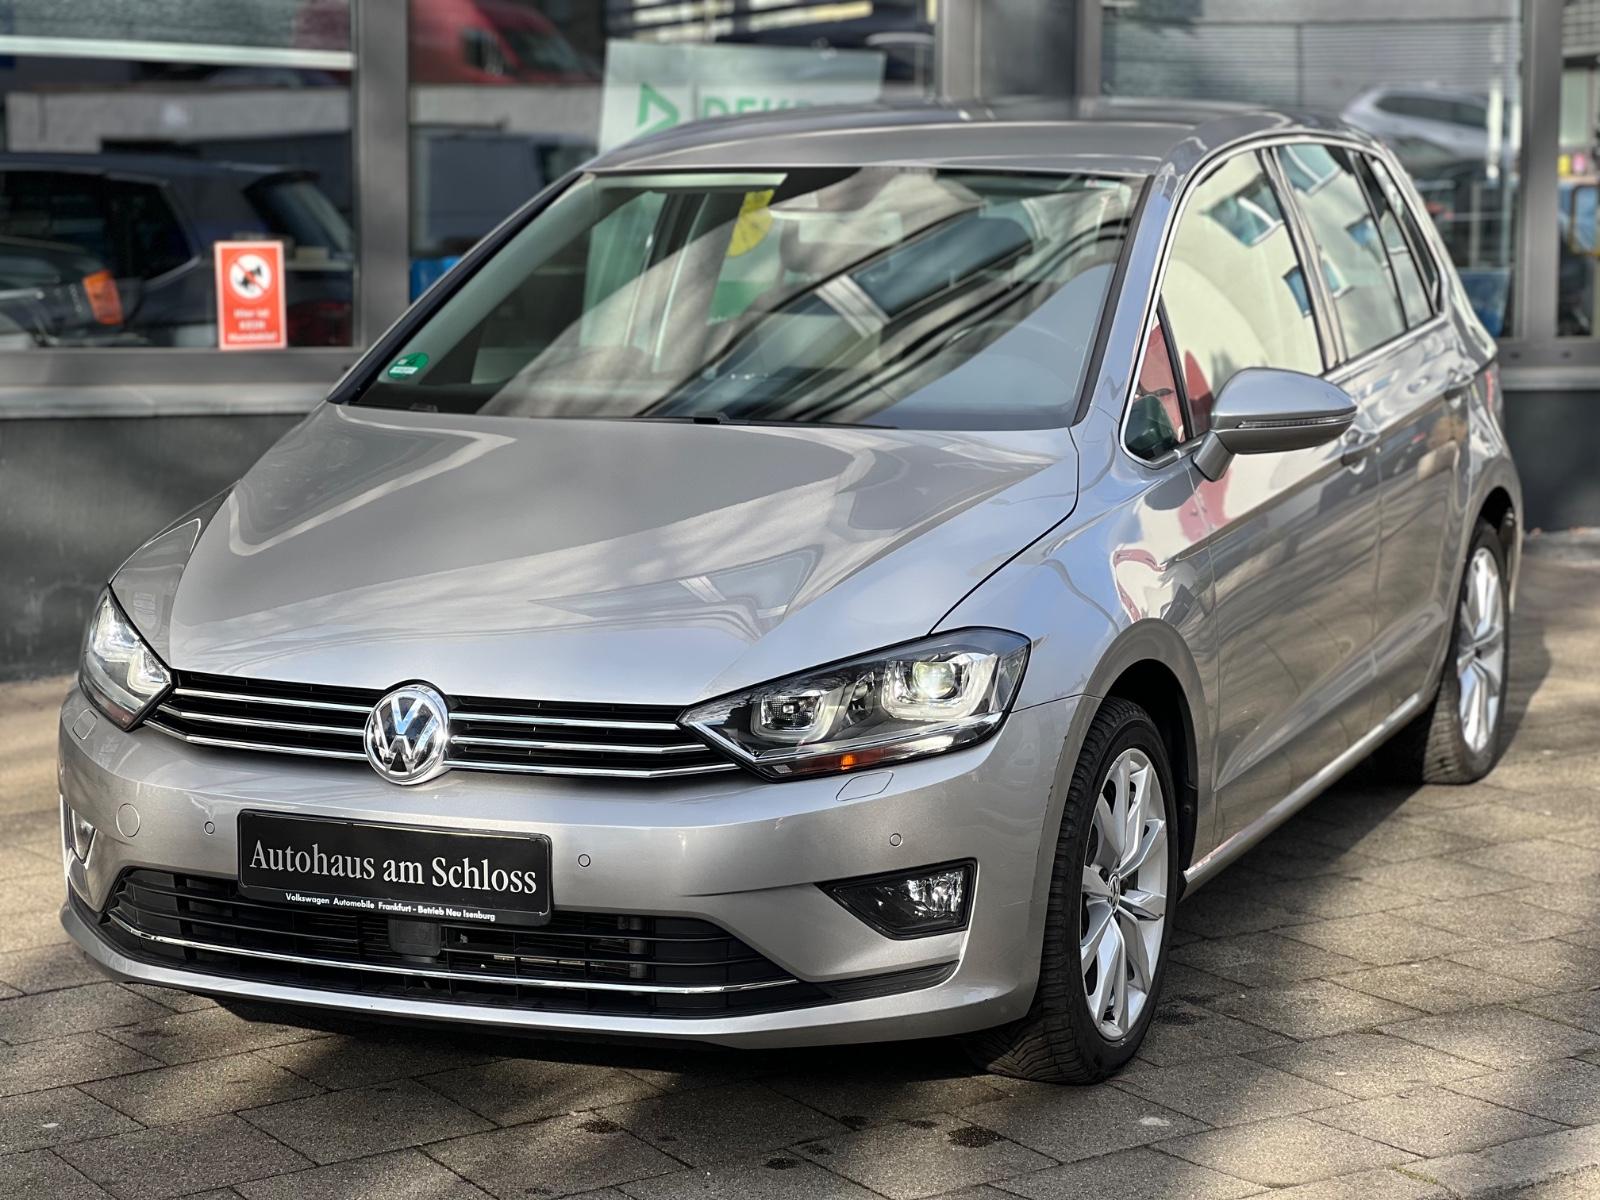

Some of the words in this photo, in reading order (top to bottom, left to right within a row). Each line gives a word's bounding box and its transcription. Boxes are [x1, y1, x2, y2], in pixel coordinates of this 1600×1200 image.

[370, 693, 443, 778] VW
[249, 839, 375, 880] Autohaus
[382, 858, 425, 885] am
[431, 856, 537, 894] Schloss
[285, 892, 330, 906] Volkswagen
[333, 897, 375, 910] Automobile
[378, 901, 412, 913] Frankfurt
[417, 905, 445, 916] Betrieb
[445, 909, 462, 918] Neu
[463, 909, 496, 922] Isenburg
